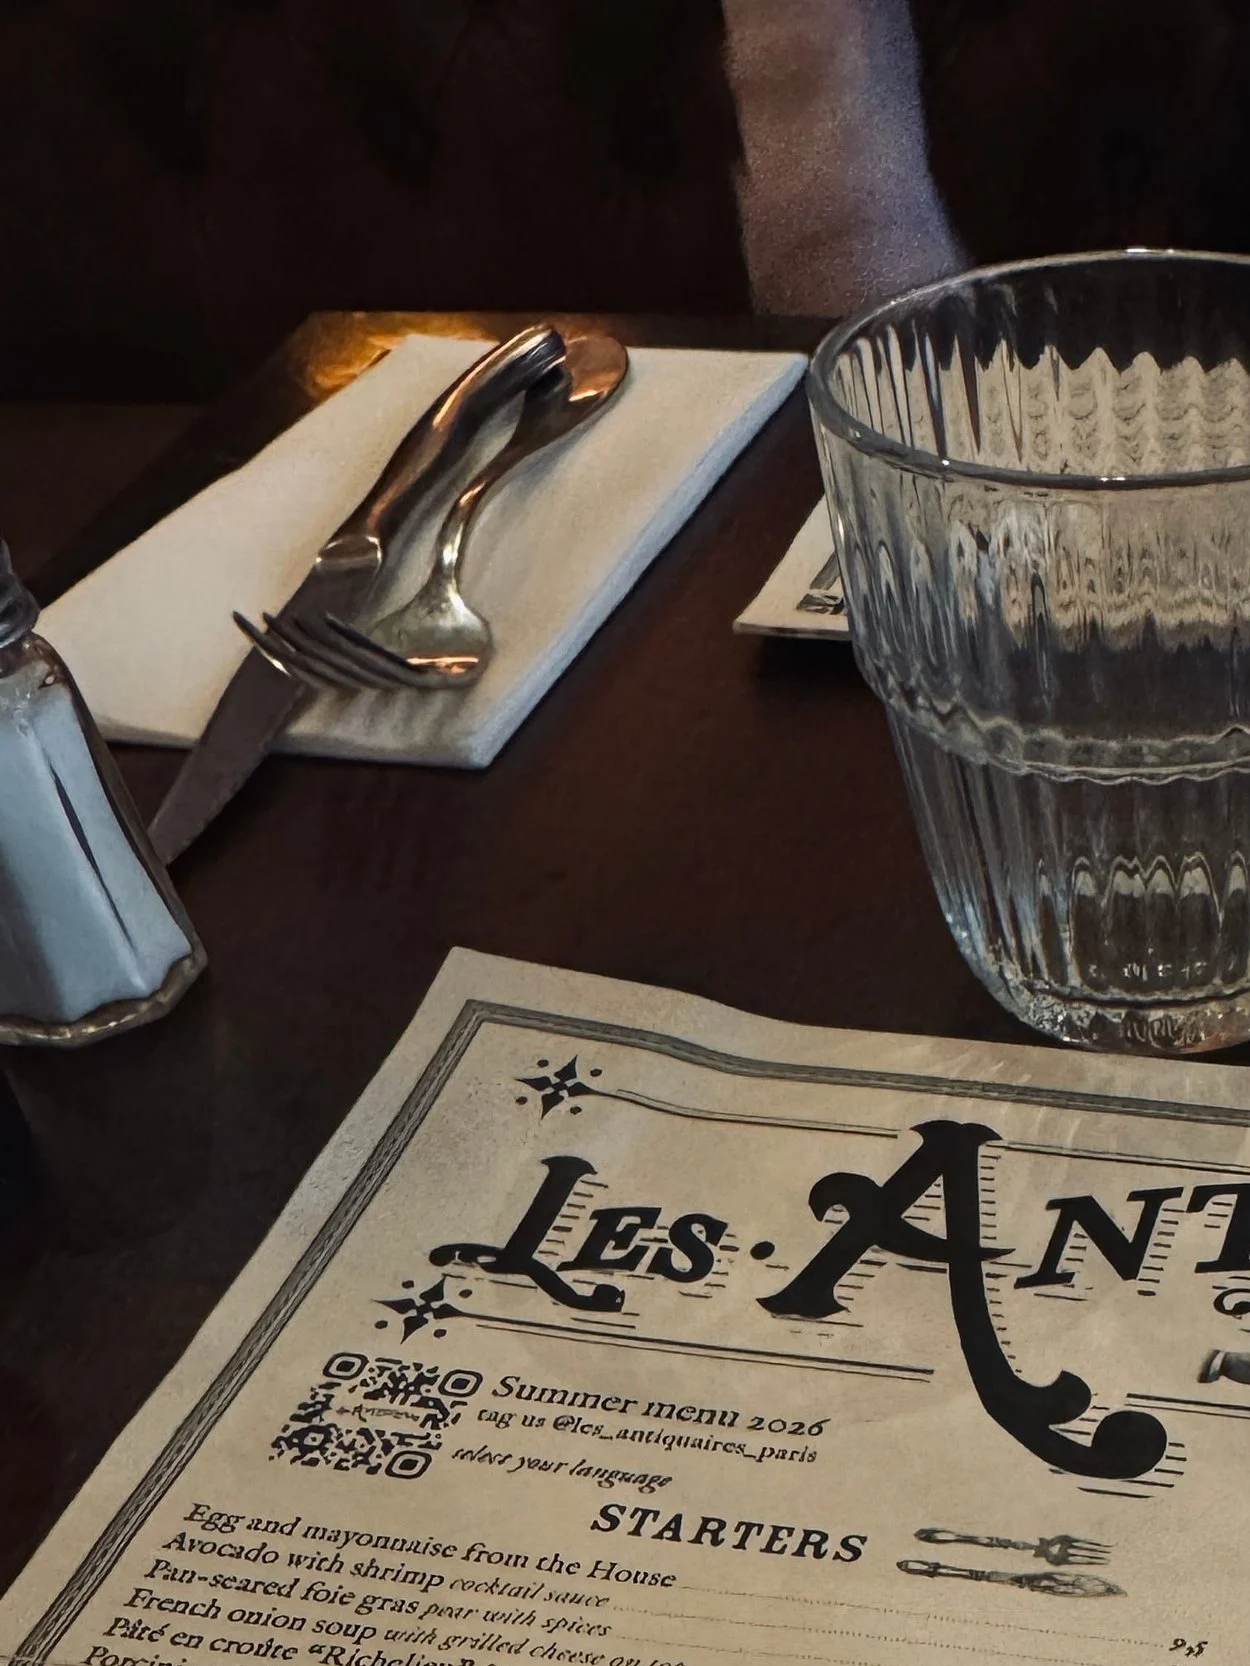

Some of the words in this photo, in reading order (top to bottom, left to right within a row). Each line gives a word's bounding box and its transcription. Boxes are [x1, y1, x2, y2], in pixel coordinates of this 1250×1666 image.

[492, 1376, 638, 1413] Summer
[641, 1402, 739, 1427] menu
[747, 1417, 831, 1436] 2026
[478, 1409, 517, 1429] tag
[521, 1415, 546, 1427] us
[553, 1415, 817, 1463] @les_antiquaires_paris
[507, 1456, 567, 1473] your
[569, 1459, 672, 1493] language
[590, 1504, 867, 1562] STARTERS
[162, 1532, 279, 1564] Avocado
[288, 1551, 344, 1573] with
[350, 1558, 444, 1593] shrimp
[450, 1577, 544, 1599] cocktail
[544, 1592, 609, 1607] sauce
[183, 1503, 245, 1534] Egg
[246, 1517, 301, 1536] and
[302, 1526, 457, 1558] mayonnaise
[461, 1543, 528, 1568] from
[536, 1553, 580, 1575] the
[587, 1560, 676, 1587] House
[1169, 1639, 1208, 1658] 9,5
